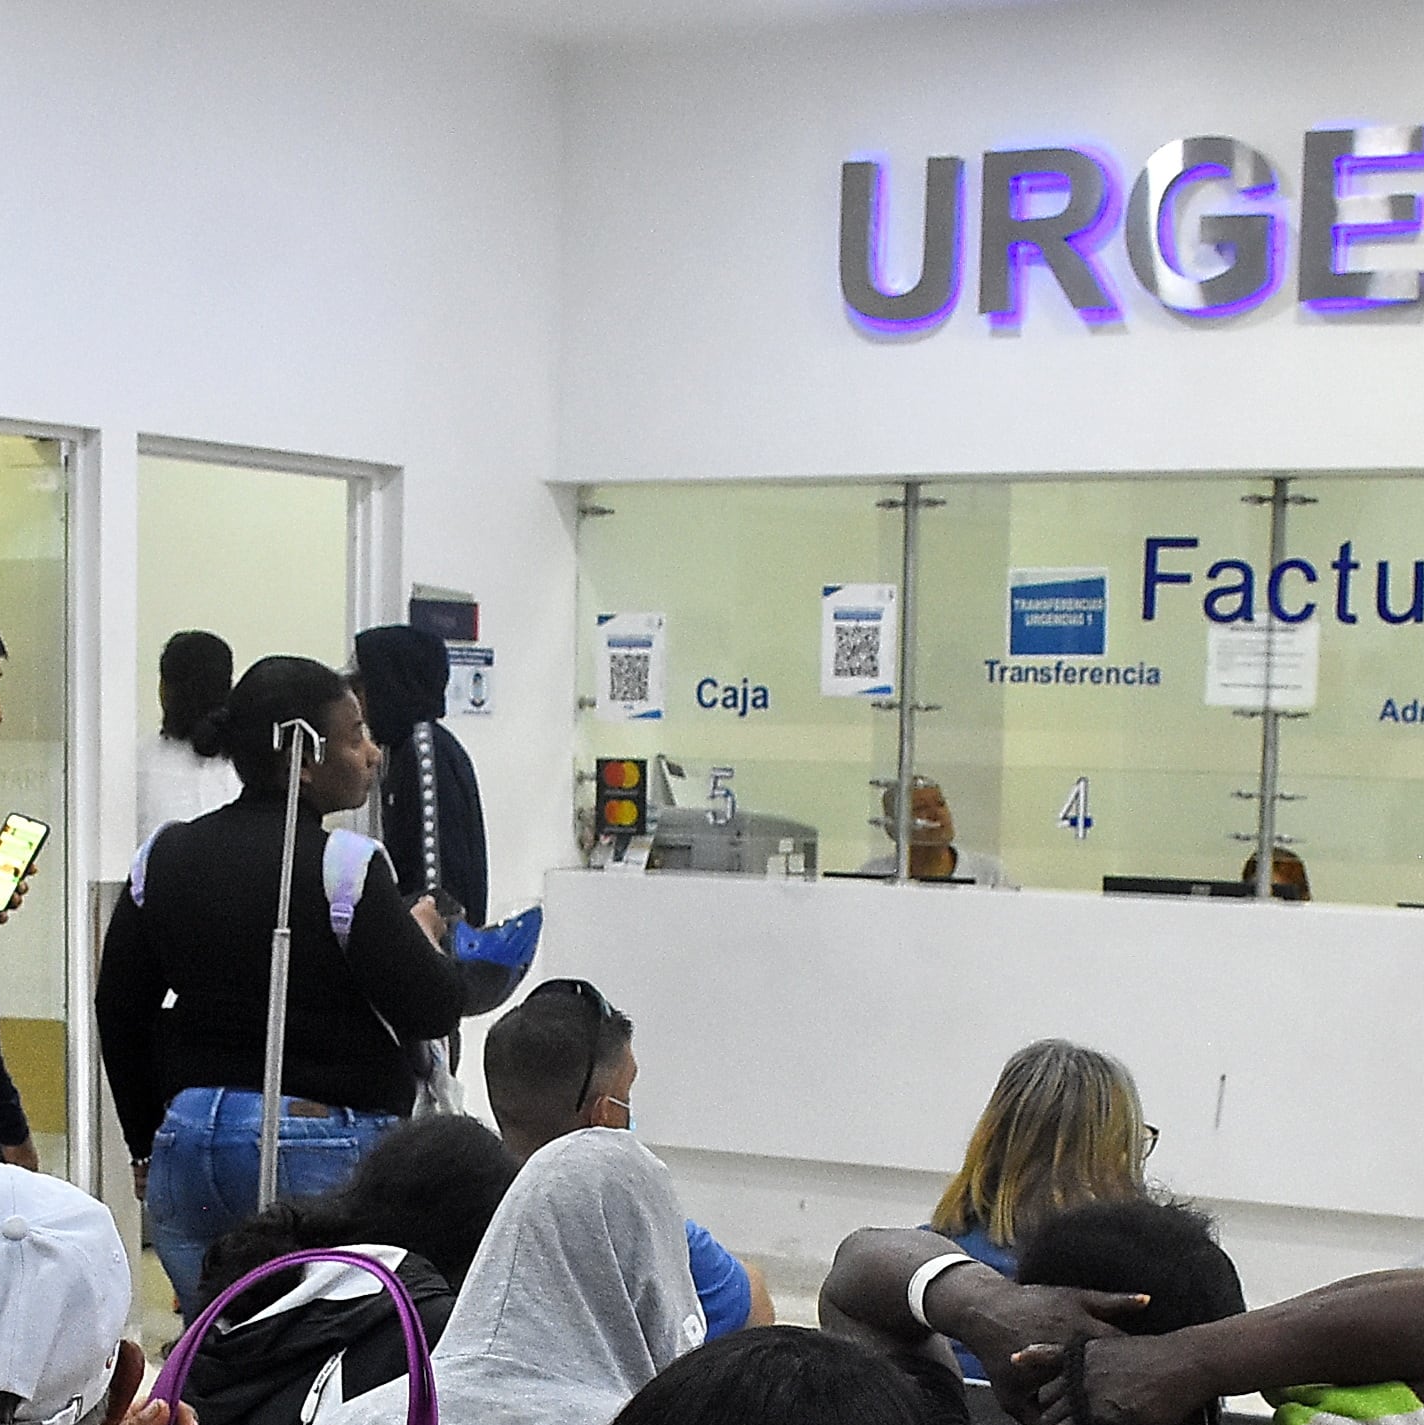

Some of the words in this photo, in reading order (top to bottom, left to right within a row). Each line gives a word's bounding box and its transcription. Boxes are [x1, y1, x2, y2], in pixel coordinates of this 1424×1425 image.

[695, 676, 770, 718] Caja
[984, 659, 1162, 686] Transferencia
[705, 766, 738, 827] 5
[1056, 776, 1094, 840] 4
